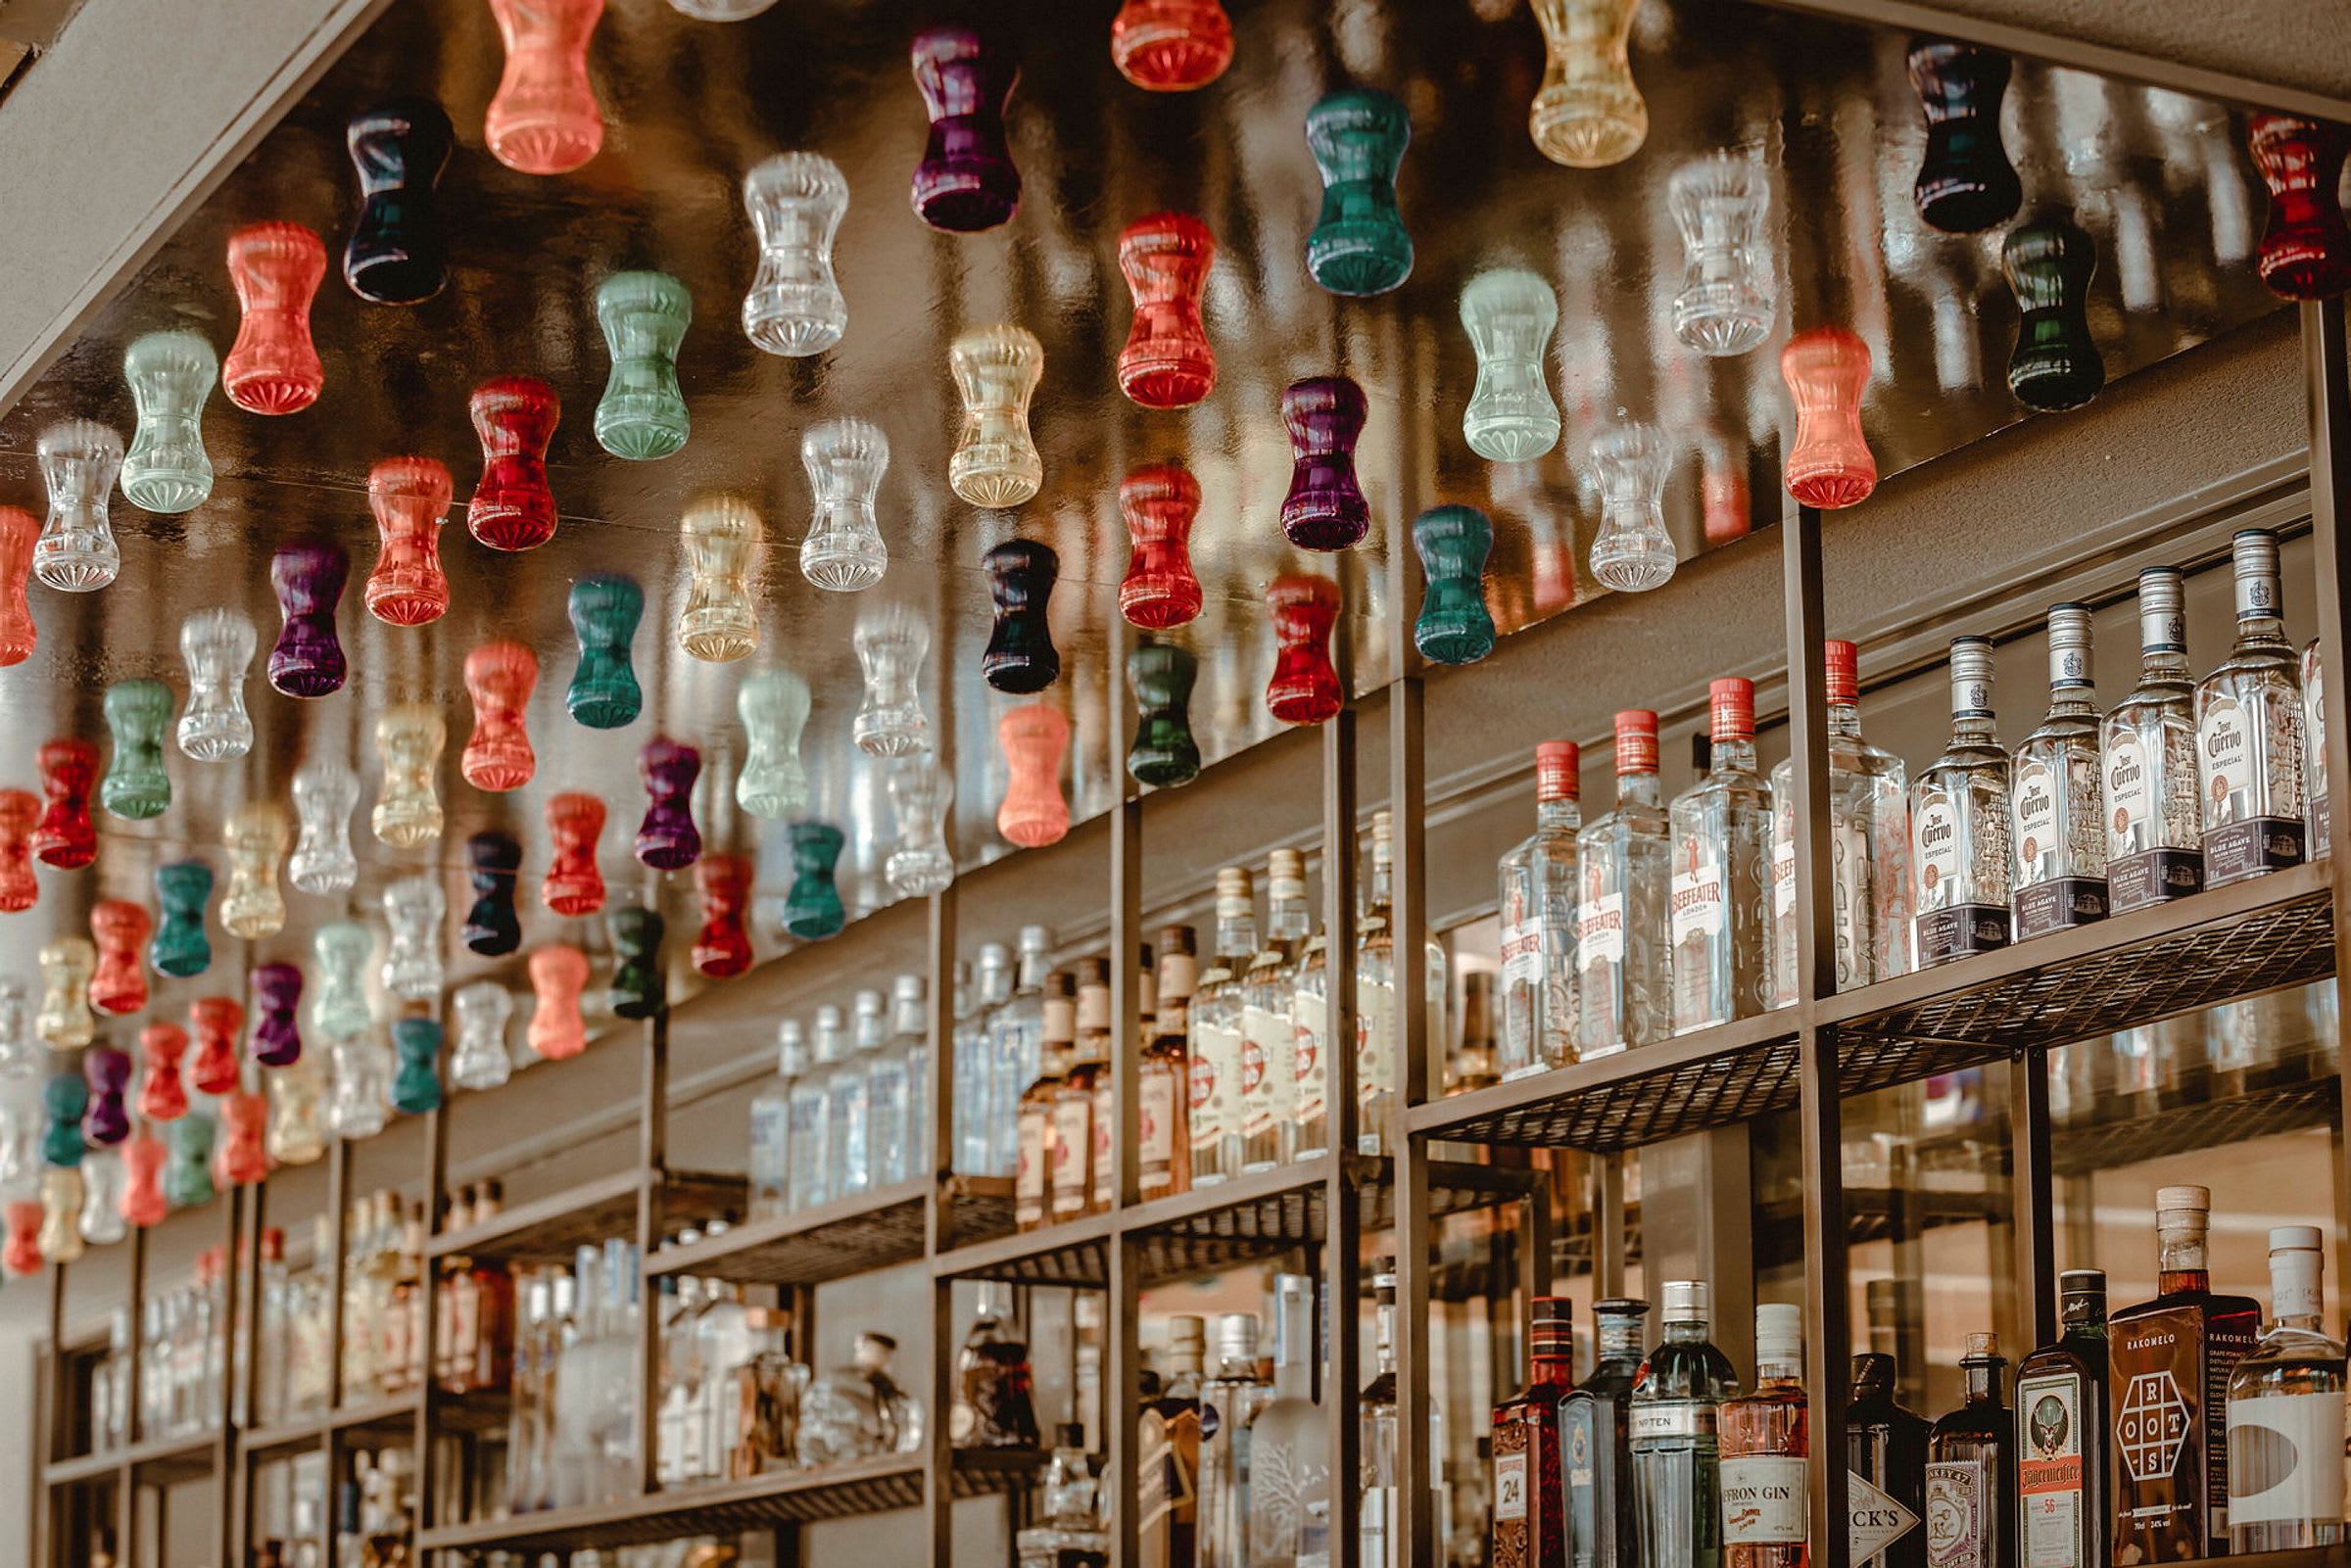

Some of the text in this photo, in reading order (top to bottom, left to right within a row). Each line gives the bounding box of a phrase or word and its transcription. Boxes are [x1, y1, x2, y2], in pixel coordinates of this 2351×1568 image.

[2208, 731, 2241, 758] Cuervo
[2212, 756, 2243, 770] ESPECIAL
[2110, 763, 2140, 791] Cuervo
[2114, 787, 2142, 803] ESPECIAL
[2020, 794, 2049, 821] Cuervo
[1921, 823, 1951, 848] Cuervo
[1671, 880, 1721, 916] BEEFEATER
[1577, 909, 1622, 941] BEEFEATER
[1500, 932, 1541, 966] BEEFEATER
[2127, 1333, 2175, 1351] RAKOMELO
[2209, 1333, 2261, 1345] RAKOMELO
[2145, 1382, 2157, 1401] R
[1650, 1417, 1671, 1427] TEN
[2148, 1452, 2157, 1471] S
[1954, 1472, 1969, 1482] 47
[1504, 1478, 1519, 1503] 24
[1762, 1487, 1790, 1500] GIN
[1848, 1509, 1898, 1527] CK'S
